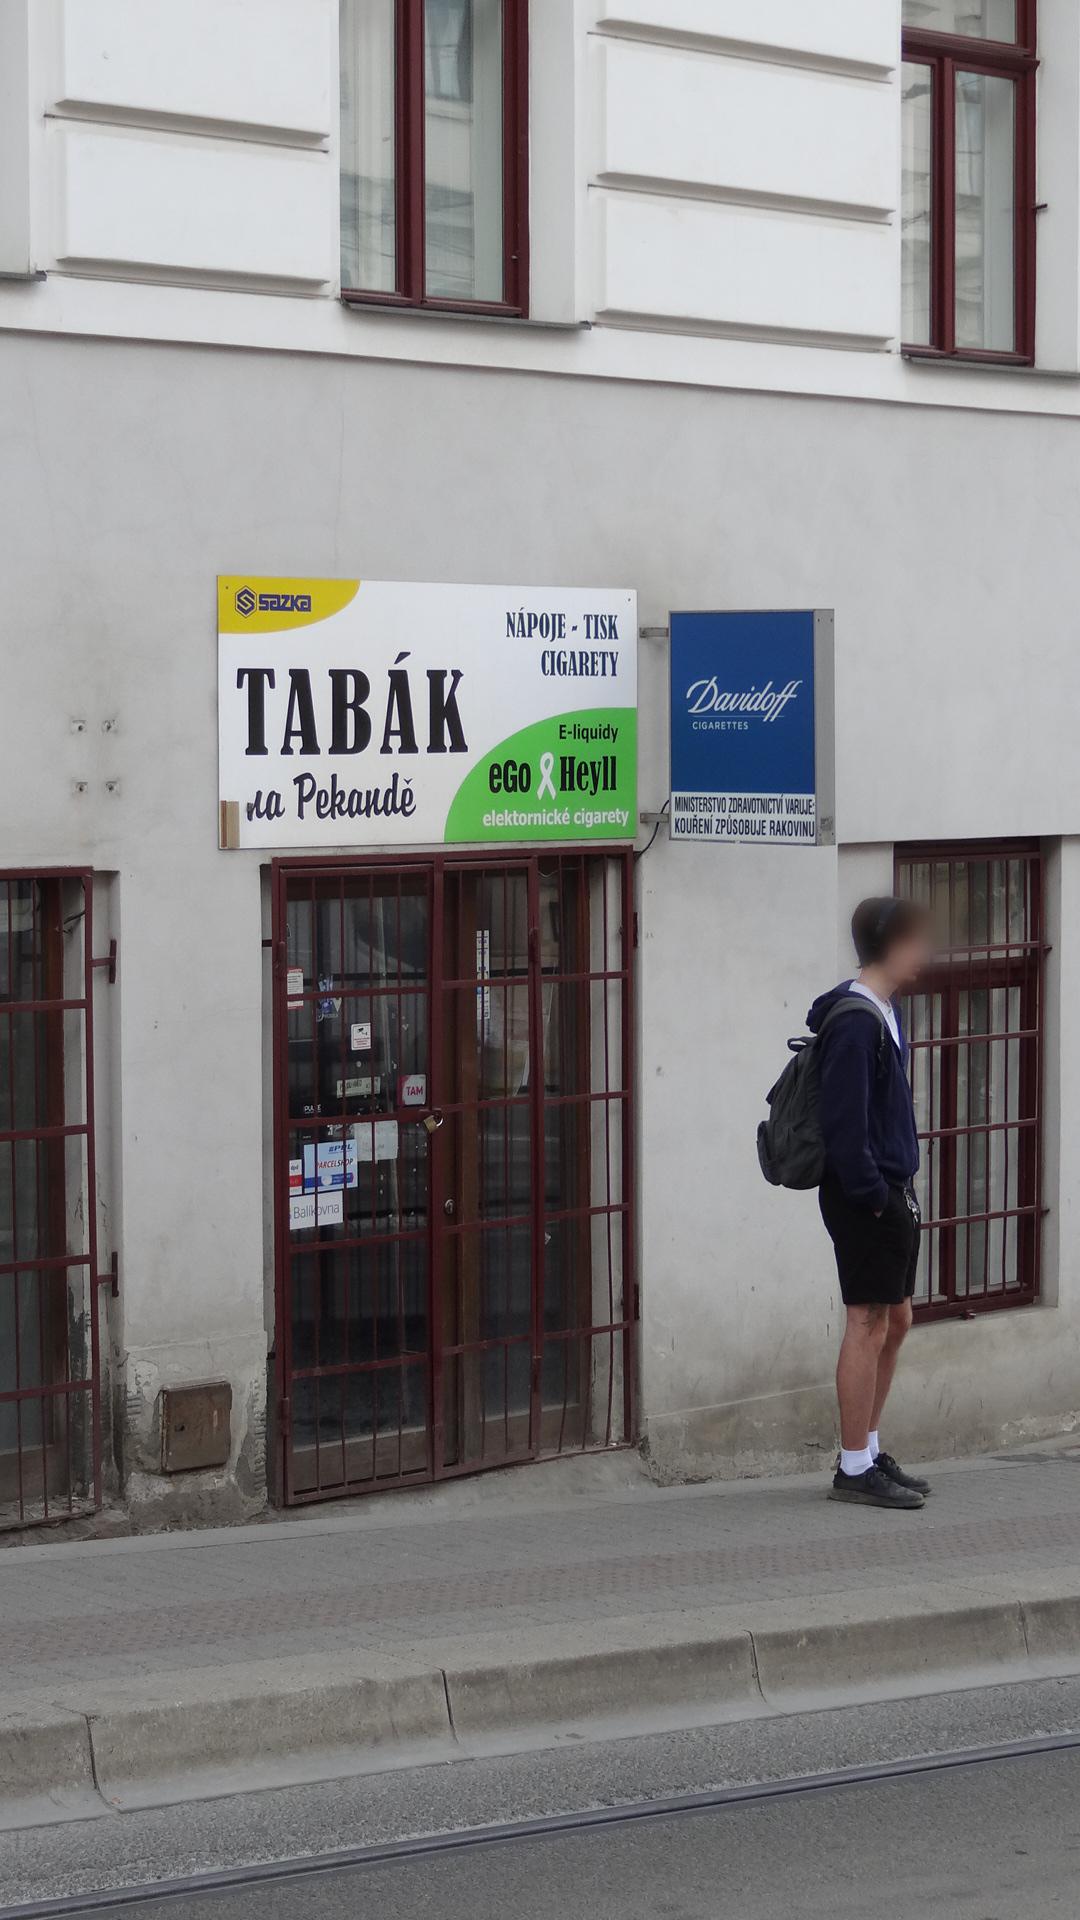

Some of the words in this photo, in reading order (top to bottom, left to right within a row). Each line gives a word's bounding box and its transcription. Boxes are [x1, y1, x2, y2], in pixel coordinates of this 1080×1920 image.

[505, 607, 566, 639] NÁPOJE
[583, 614, 620, 640] TISK
[540, 650, 620, 677] CIGARETY
[236, 651, 469, 756] TABÁK
[686, 675, 803, 722] Davidoff
[559, 723, 619, 743] E-liquidy
[692, 721, 749, 730] CIGARETTES
[488, 760, 531, 793] eGo
[559, 756, 617, 795] Heyll
[292, 772, 417, 820] Pekandě
[674, 796, 727, 813] MINISTERSTVO
[728, 793, 784, 814] ZDRAVOTNICTVÍ
[785, 800, 815, 815] VARUJE:
[482, 808, 571, 828] elektornické
[573, 808, 630, 829] cigarety
[674, 814, 714, 834] KOUŘENÍ
[715, 815, 767, 836] ZPŮSOBUJE
[769, 819, 815, 837] RAKOVINU
[406, 1086, 424, 1096] TAM
[318, 1158, 354, 1169] ARCELSHOP
